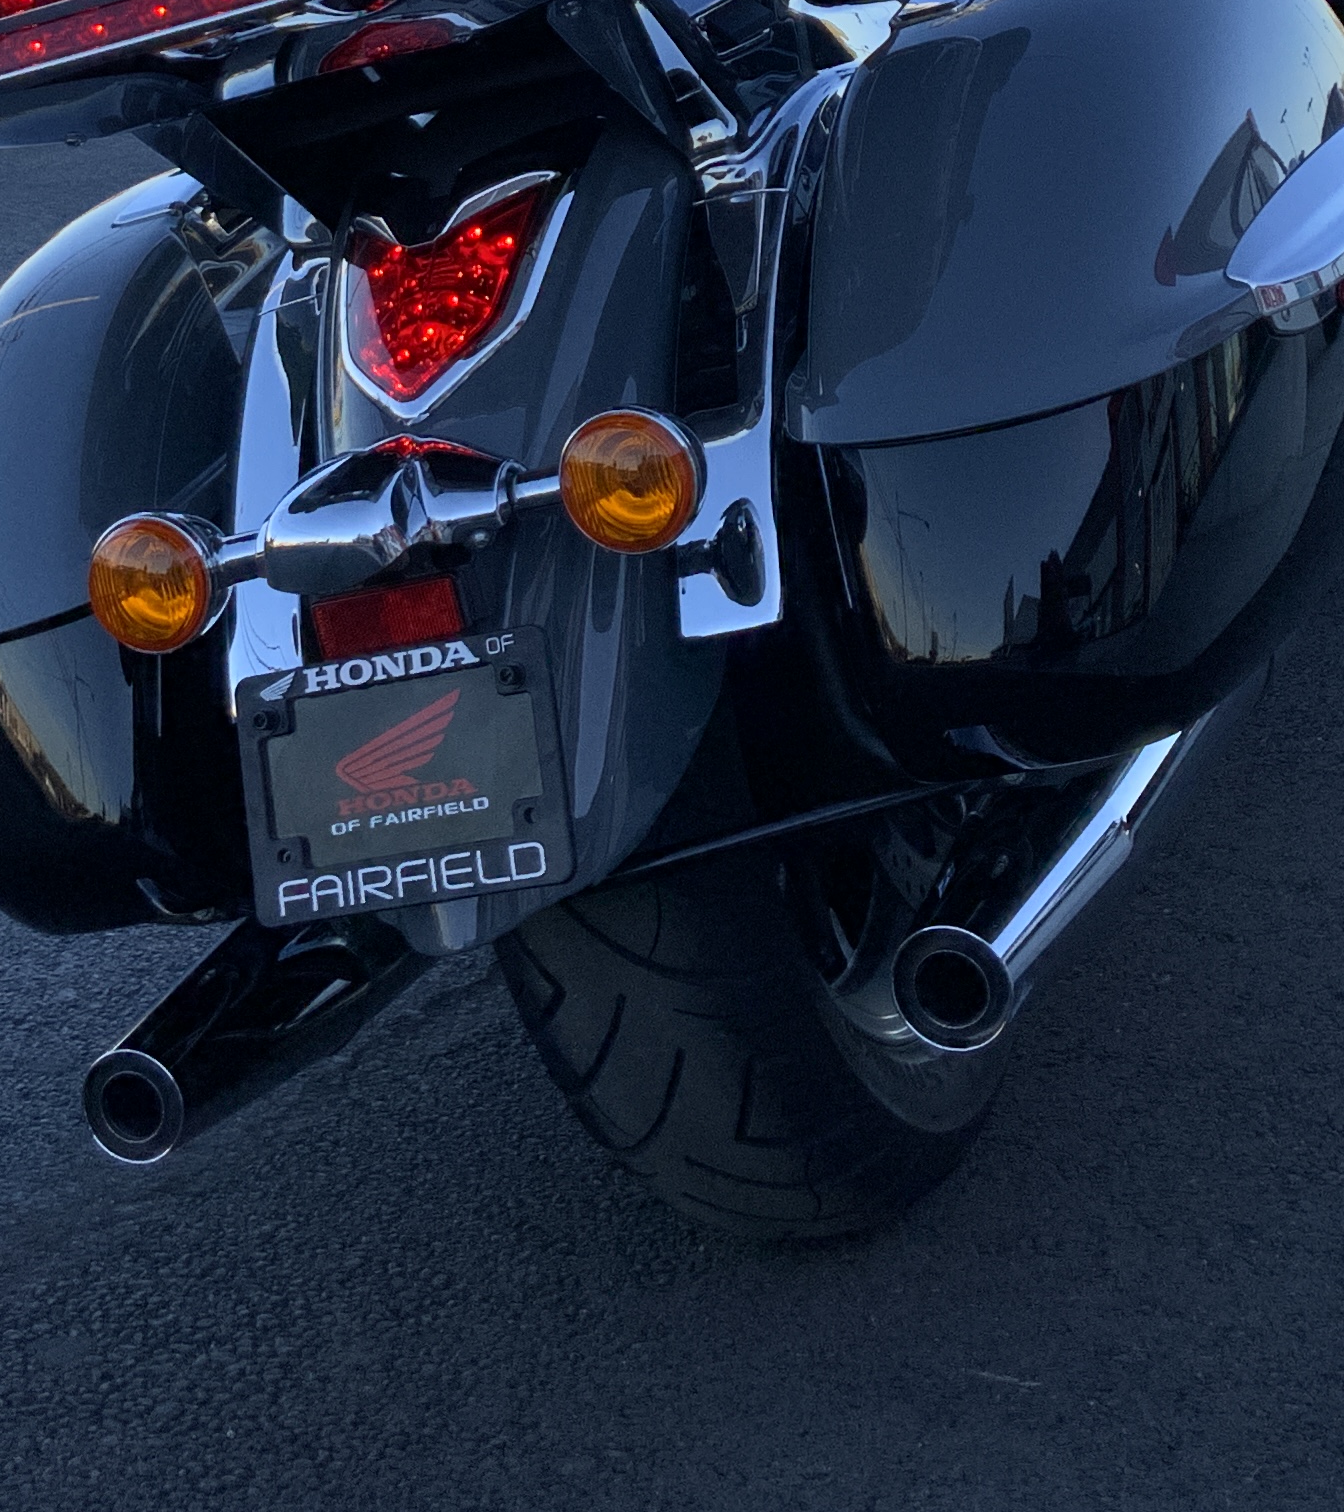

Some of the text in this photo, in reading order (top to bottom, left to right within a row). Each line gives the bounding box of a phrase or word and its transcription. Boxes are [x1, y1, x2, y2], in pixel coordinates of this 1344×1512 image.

[303, 633, 515, 694] HONDA OF
[330, 796, 490, 836] OF FAIRFIELD
[337, 778, 479, 817] HONDA
[277, 841, 547, 918] FAIRFIELD
